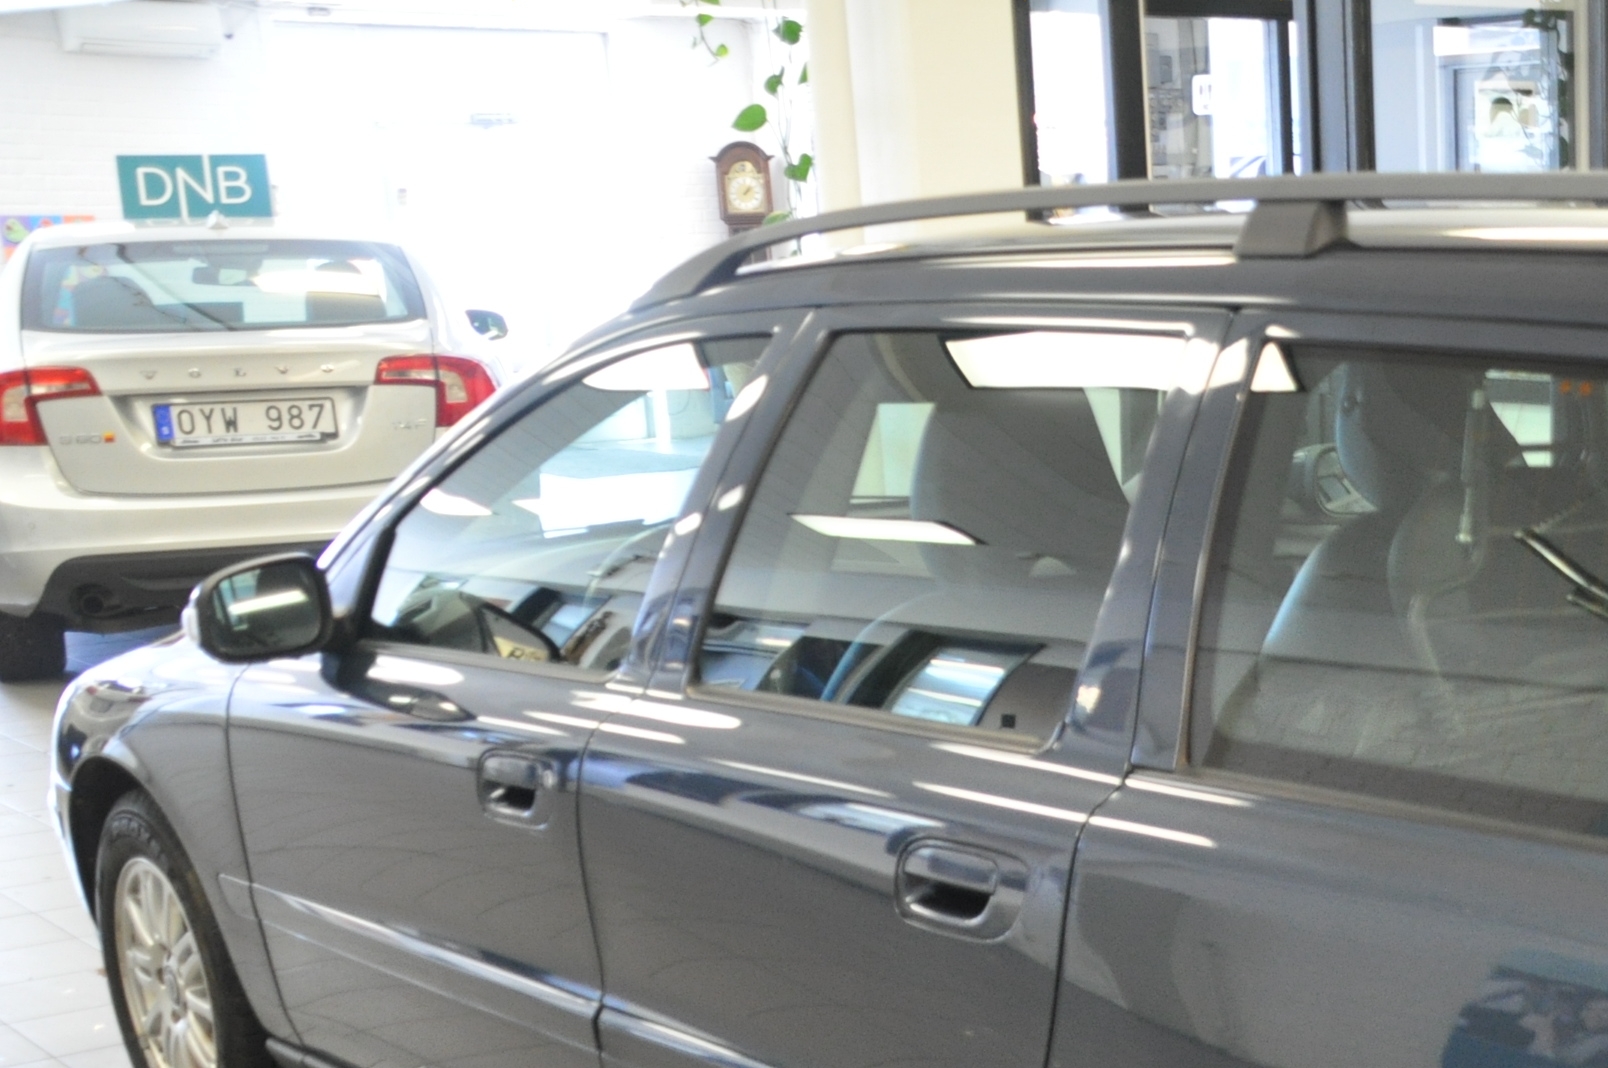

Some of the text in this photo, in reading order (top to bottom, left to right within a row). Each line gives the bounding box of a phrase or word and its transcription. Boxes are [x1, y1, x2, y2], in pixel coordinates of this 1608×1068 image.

[136, 156, 252, 217] DNB
[139, 364, 334, 380] VOLVO
[177, 403, 326, 436] OYW 987
